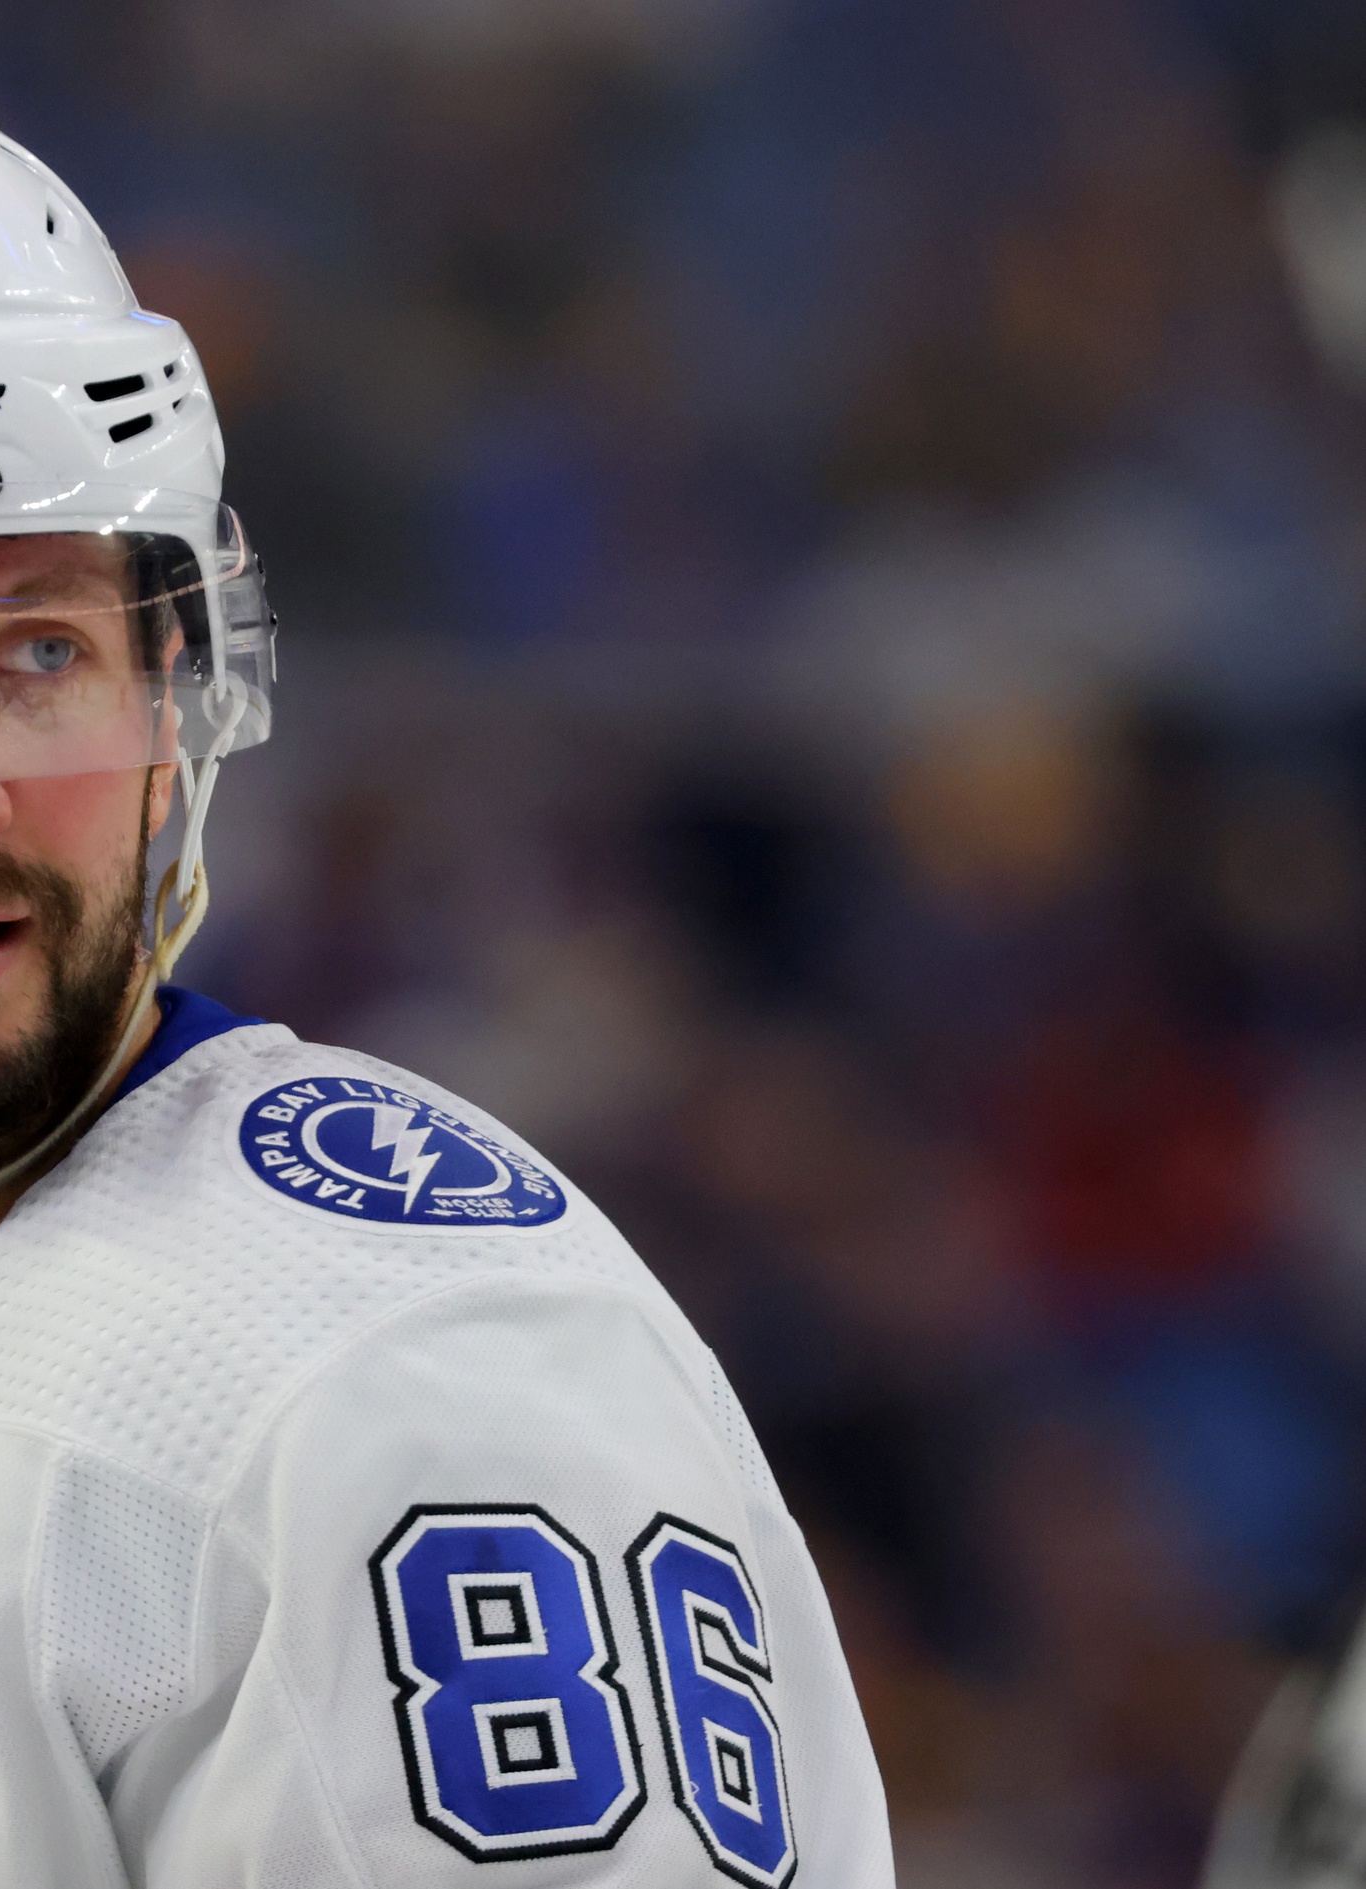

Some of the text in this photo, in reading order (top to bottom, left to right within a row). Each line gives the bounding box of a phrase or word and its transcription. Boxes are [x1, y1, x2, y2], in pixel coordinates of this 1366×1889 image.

[257, 1082, 327, 1124] BAY
[255, 1129, 367, 1210] TAMPA
[434, 1197, 514, 1209] HOCKEY
[466, 1205, 516, 1219] CLUB
[368, 1503, 798, 1889] 86
